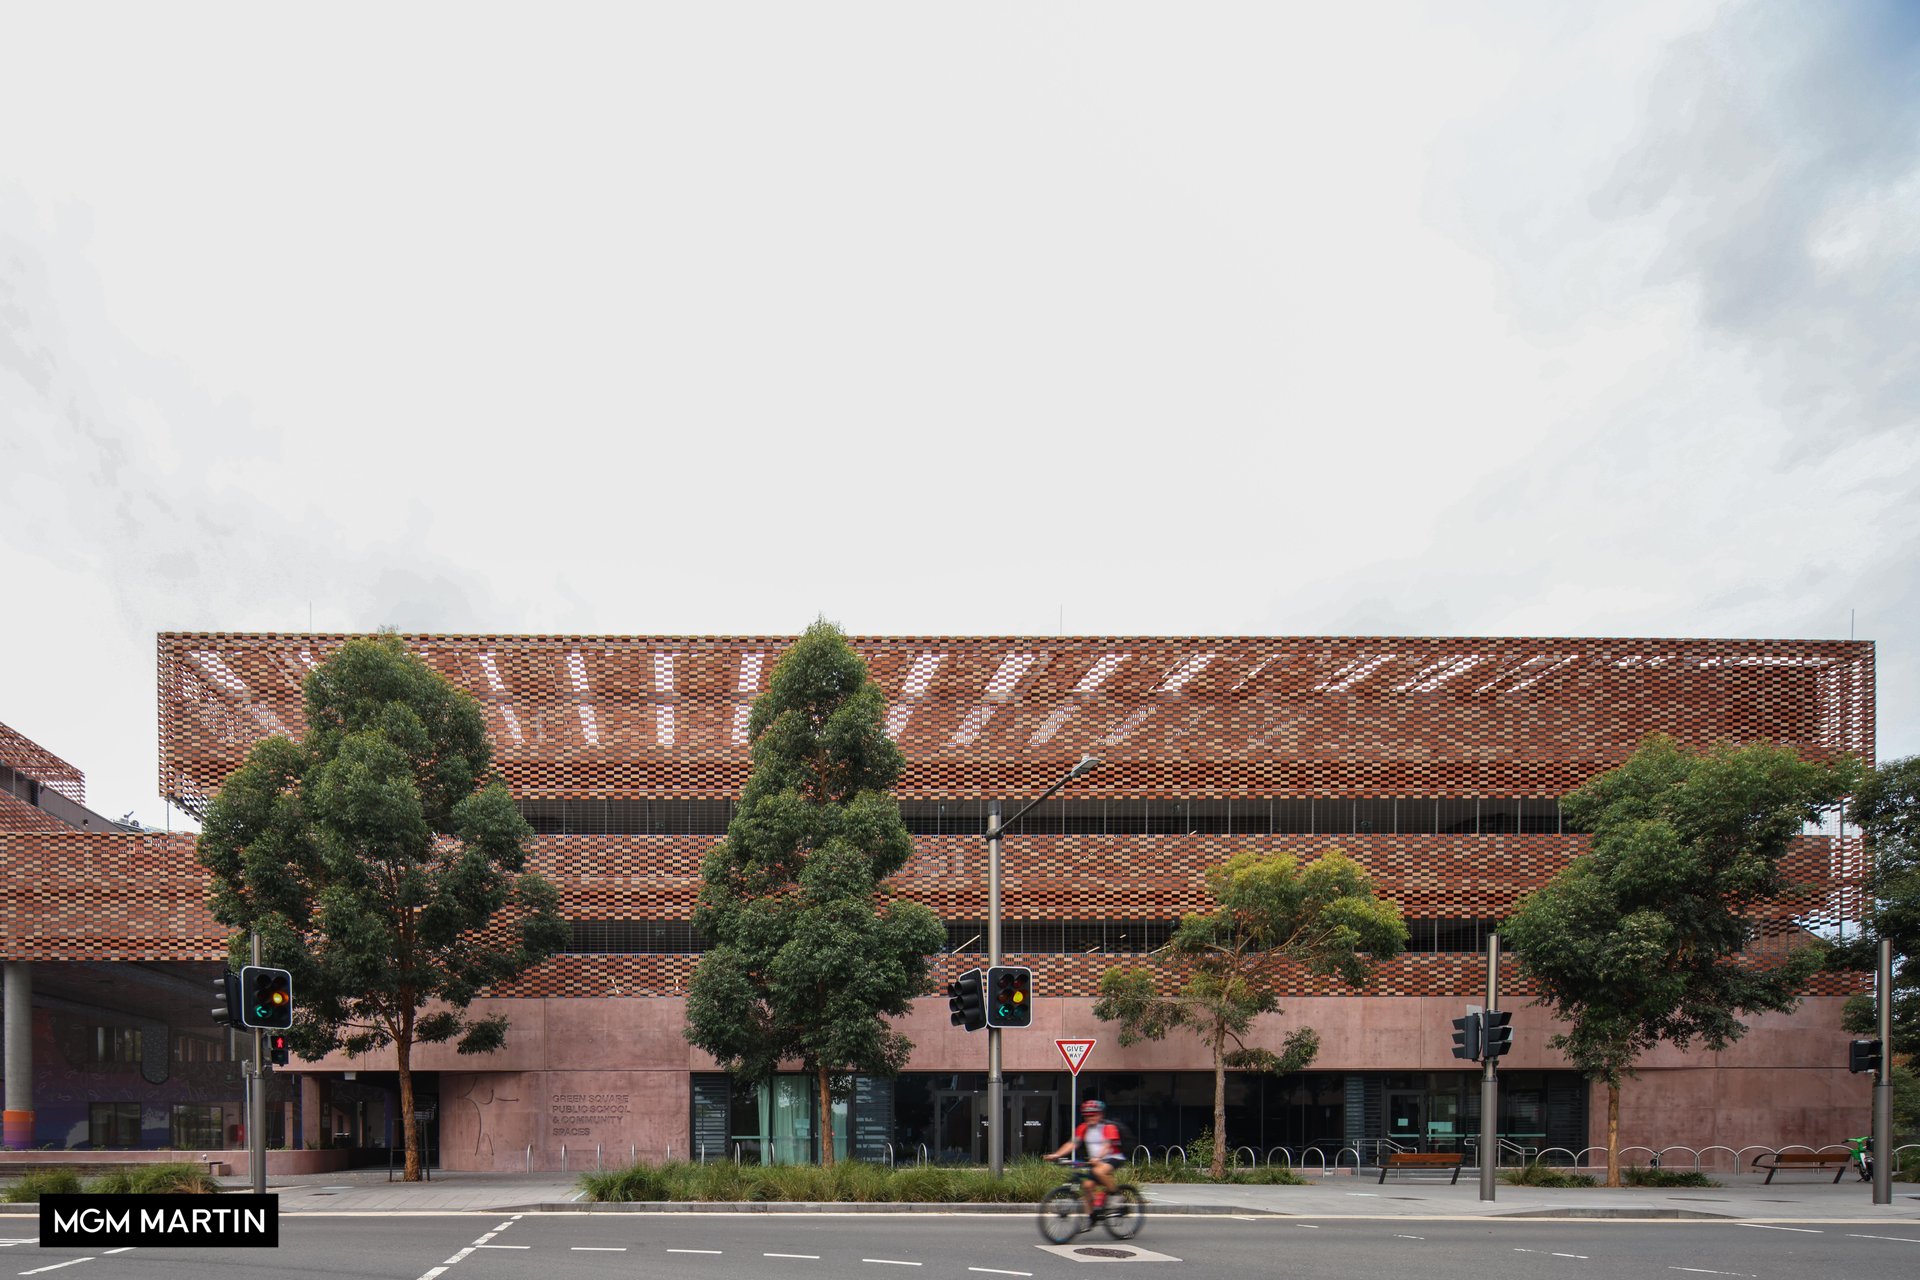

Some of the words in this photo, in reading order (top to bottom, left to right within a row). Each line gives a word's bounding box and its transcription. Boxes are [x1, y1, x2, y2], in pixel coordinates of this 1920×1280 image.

[552, 1094, 586, 1103] GREEN
[588, 1094, 629, 1103] SQUARE
[552, 1105, 588, 1113] PUBLIC
[590, 1105, 631, 1113] SCHOOL
[552, 1115, 559, 1124] &
[561, 1116, 623, 1124] COMMUNITY
[552, 1127, 591, 1136] SPACES
